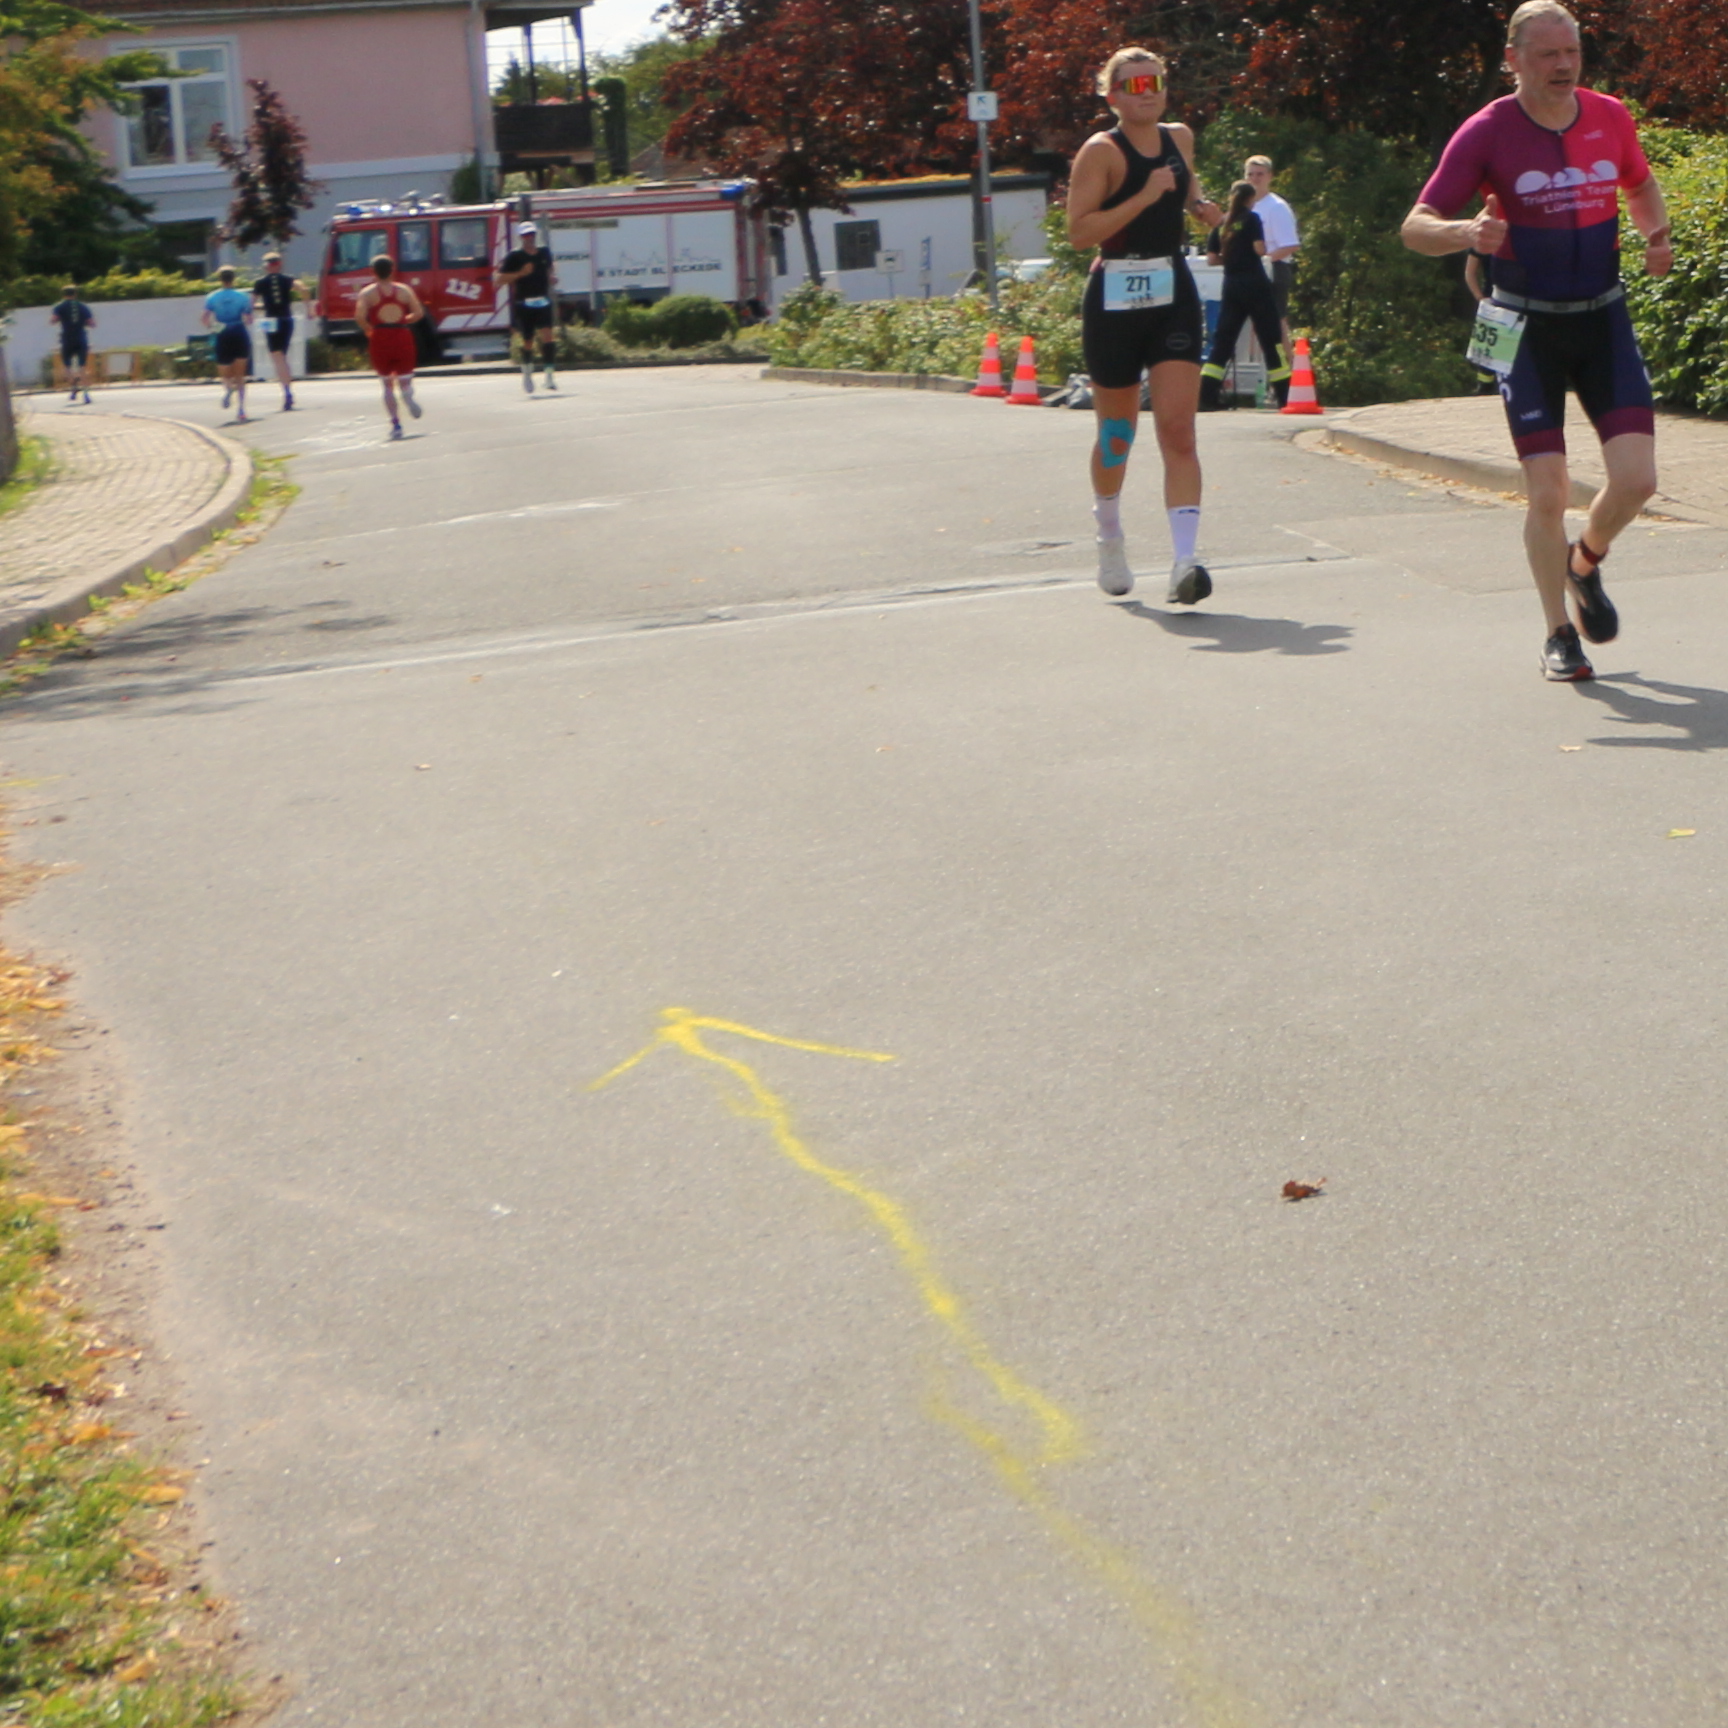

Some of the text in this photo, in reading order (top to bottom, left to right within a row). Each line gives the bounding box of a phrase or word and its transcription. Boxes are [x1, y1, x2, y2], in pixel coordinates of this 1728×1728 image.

[1521, 185, 1616, 206] Triathlon Team
[609, 267, 647, 277] STADT
[445, 278, 482, 300] 112
[1126, 275, 1151, 292] 271
[1472, 323, 1498, 347] 35
